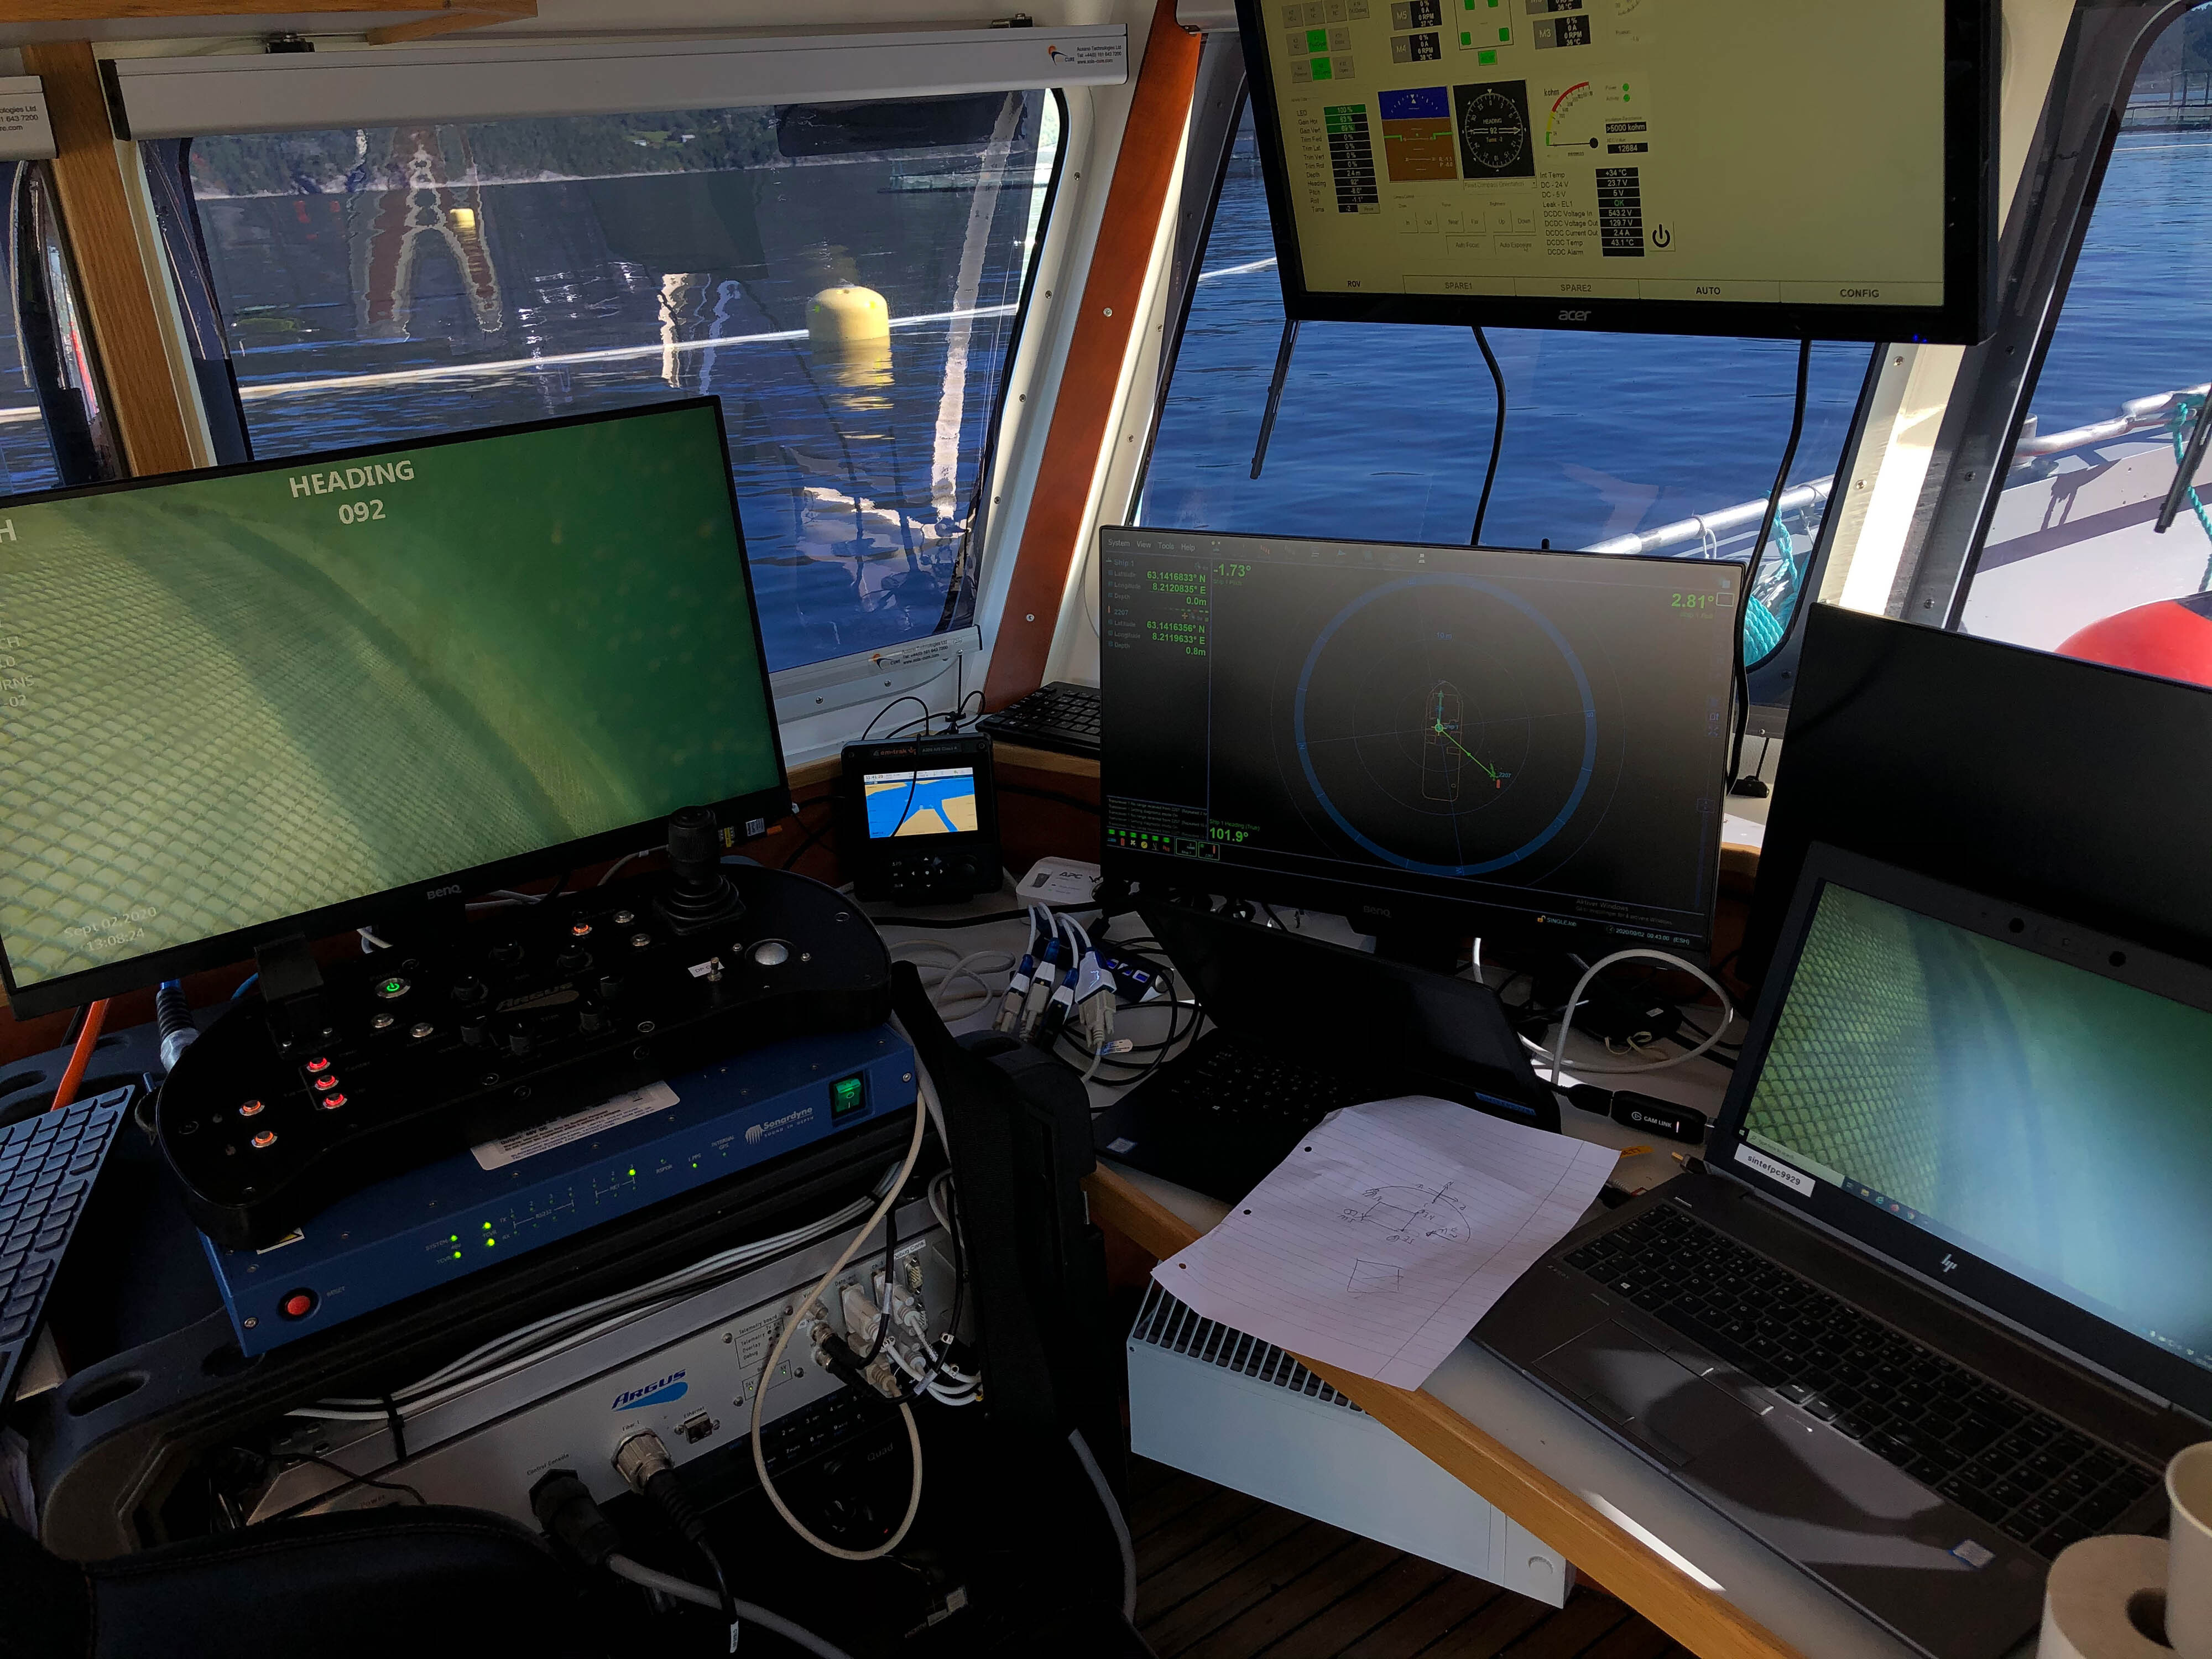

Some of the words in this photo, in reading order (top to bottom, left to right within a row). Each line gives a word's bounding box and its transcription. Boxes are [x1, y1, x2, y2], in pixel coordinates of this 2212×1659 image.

[1396, 11, 1407, 20] M5
[1540, 29, 1551, 38] M3
[1396, 45, 1407, 53] M4
[1544, 88, 1559, 97] kohm
[1347, 280, 1361, 288] ROV
[1444, 281, 1473, 290] SPARE1
[1560, 283, 1592, 293] SPARE2
[1695, 286, 1721, 295] AUTO
[1840, 289, 1880, 298] CONFIG
[1558, 310, 1592, 321] acer
[289, 460, 415, 499] HEADING
[338, 499, 387, 525] 092
[1108, 539, 1130, 548] System
[1136, 540, 1151, 549] View
[1158, 541, 1175, 551] Tools
[1181, 543, 1195, 552] Help
[1146, 570, 1197, 582] 63.1416833°
[1199, 574, 1206, 583] N
[1213, 563, 1251, 578] -1.73°
[1152, 582, 1197, 594] 8.2120835°
[1200, 586, 1206, 594] E
[1186, 597, 1207, 607] 0.0m
[1671, 593, 1714, 610] 2.81°
[1146, 620, 1196, 633] 63.1416356°
[1198, 625, 1205, 634] N
[1199, 637, 1206, 645] E
[1114, 641, 1130, 650] Depth
[1186, 646, 1206, 656] 0.8m
[1225, 821, 1245, 830] Heading
[1210, 827, 1249, 843] 101.9°
[426, 884, 463, 901] BenQ
[1600, 901, 1629, 912] Windows
[123, 906, 157, 924] 2020
[87, 927, 144, 952] 13:08:24
[763, 1107, 813, 1130] Sonardyne
[796, 1115, 814, 1126] DEPTH
[1644, 1116, 1658, 1125] CAM
[1658, 1119, 1673, 1129] LINK
[1746, 1154, 1802, 1186] sintefpc9929
[1941, 1253, 1958, 1273] hp
[327, 1286, 346, 1297] RESET
[739, 1321, 763, 1335] Telemetry
[763, 1314, 778, 1324] board
[741, 1332, 765, 1345] Telemetry
[742, 1342, 761, 1353] Overlay
[743, 1350, 759, 1360] Debug
[611, 1369, 686, 1410] ARGUS
[683, 1406, 705, 1420] Ethernet
[622, 1422, 636, 1432] Fiber
[867, 1442, 894, 1462] Quad
[526, 1462, 547, 1476] Control
